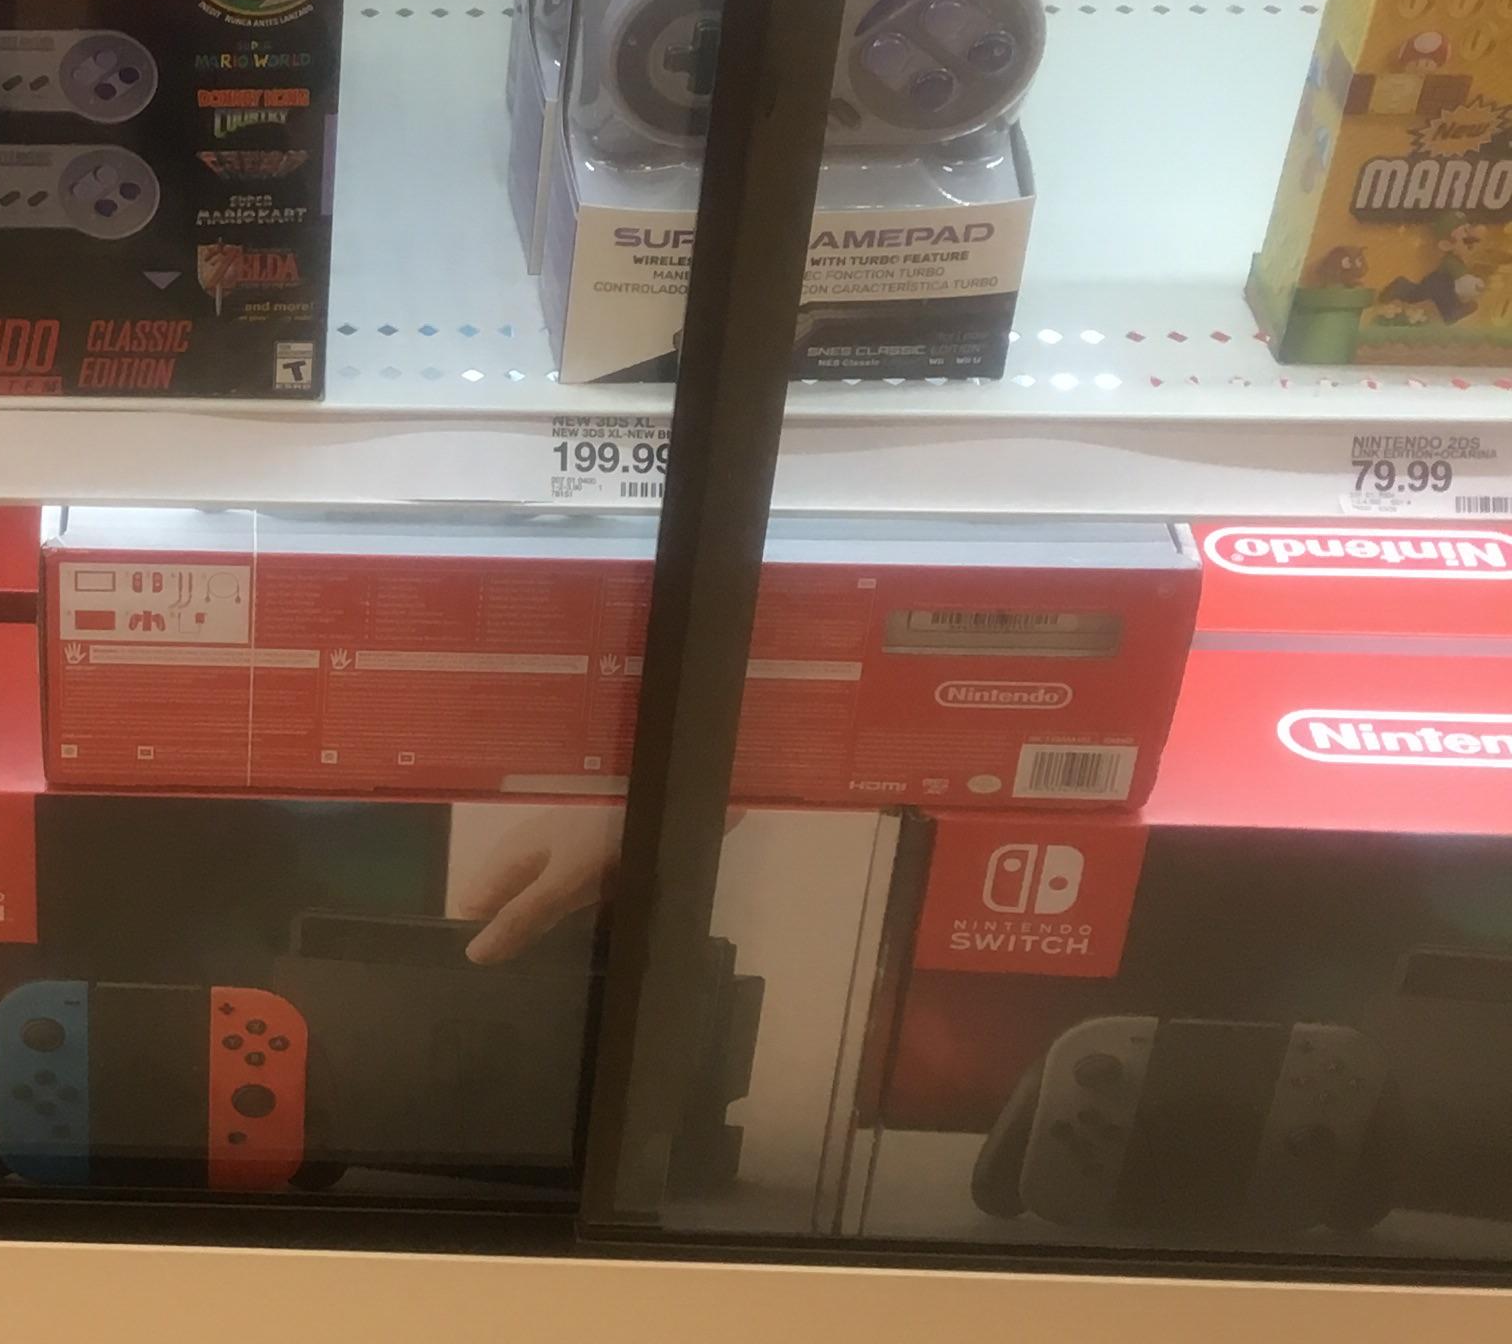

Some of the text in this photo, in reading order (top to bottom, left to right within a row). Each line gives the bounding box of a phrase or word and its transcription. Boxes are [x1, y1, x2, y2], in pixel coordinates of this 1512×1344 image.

[1431, 120, 1490, 142] New
[1355, 158, 1512, 210] MARIO
[614, 222, 995, 251] SUP AMEPAD
[810, 256, 846, 267] WITH
[850, 254, 900, 266] TURBO
[903, 251, 970, 264] FEATURE
[825, 269, 895, 281] FONCTION
[899, 267, 945, 278] TURBO
[593, 281, 689, 295] CONTROLADO
[953, 276, 998, 289] TURBO
[87, 319, 193, 353] CLASSIC
[807, 347, 852, 357] SNES
[855, 345, 927, 356] CLASSIC
[78, 358, 177, 389] EDITION
[282, 360, 306, 381] T
[552, 416, 656, 429] NEW 3DS XL
[552, 428, 579, 438] NEW
[582, 428, 605, 439] 3DS
[1352, 436, 1481, 450] NINTENDO 2DS
[553, 440, 670, 474] 199.99
[1351, 448, 1382, 459] LINK
[1351, 459, 1453, 492] 79.99
[1234, 537, 1507, 568] Nintendo
[947, 686, 1060, 704] Nintendo
[1308, 721, 1512, 755] Ninten
[953, 919, 1093, 936] NINTENDO
[949, 932, 1089, 955] SWITCH
